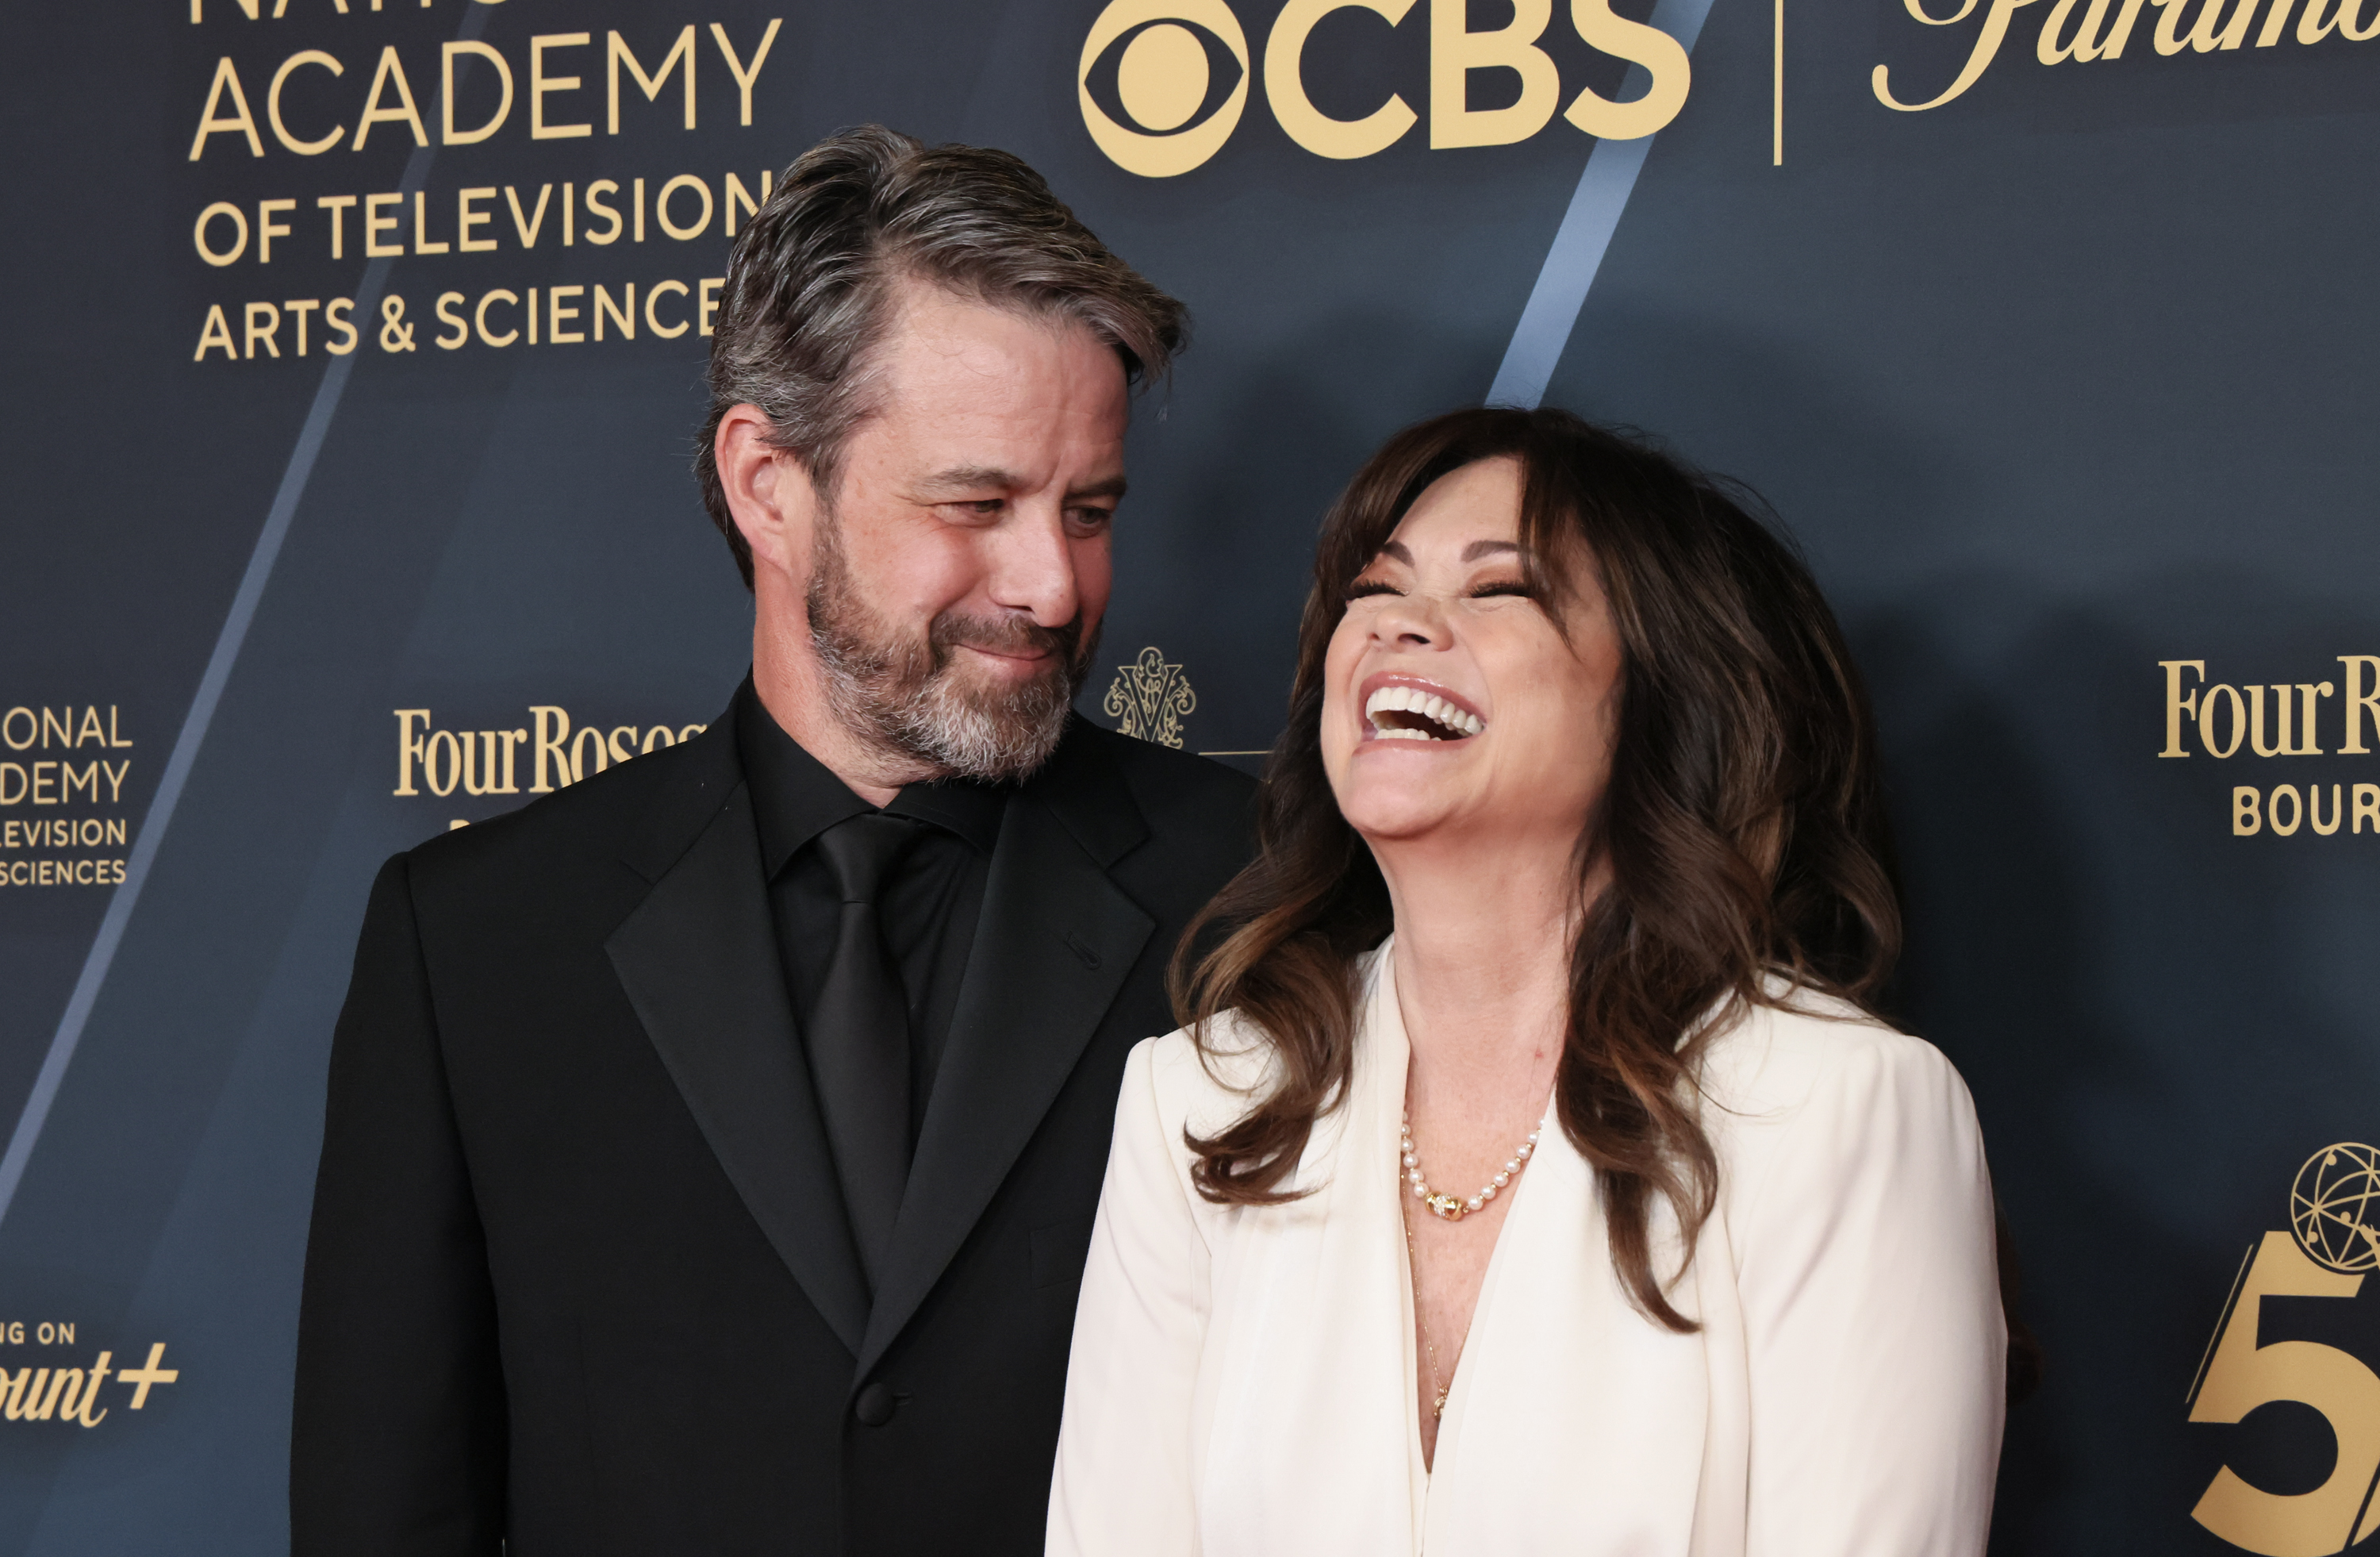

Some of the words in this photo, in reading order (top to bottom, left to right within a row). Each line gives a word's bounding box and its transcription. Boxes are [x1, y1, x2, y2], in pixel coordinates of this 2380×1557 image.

[189, 18, 783, 161] ACADEMY
[1264, 0, 1691, 160] CBS
[194, 199, 296, 266] OF
[317, 171, 771, 260] TELEVISION
[194, 298, 358, 362] ARTS
[380, 294, 416, 353] &
[2, 705, 133, 750] ONAL
[0, 759, 130, 805] DEMY
[0, 819, 126, 848] EVISION
[2232, 783, 2380, 836] BOUR
[37, 1322, 75, 1345] ON
